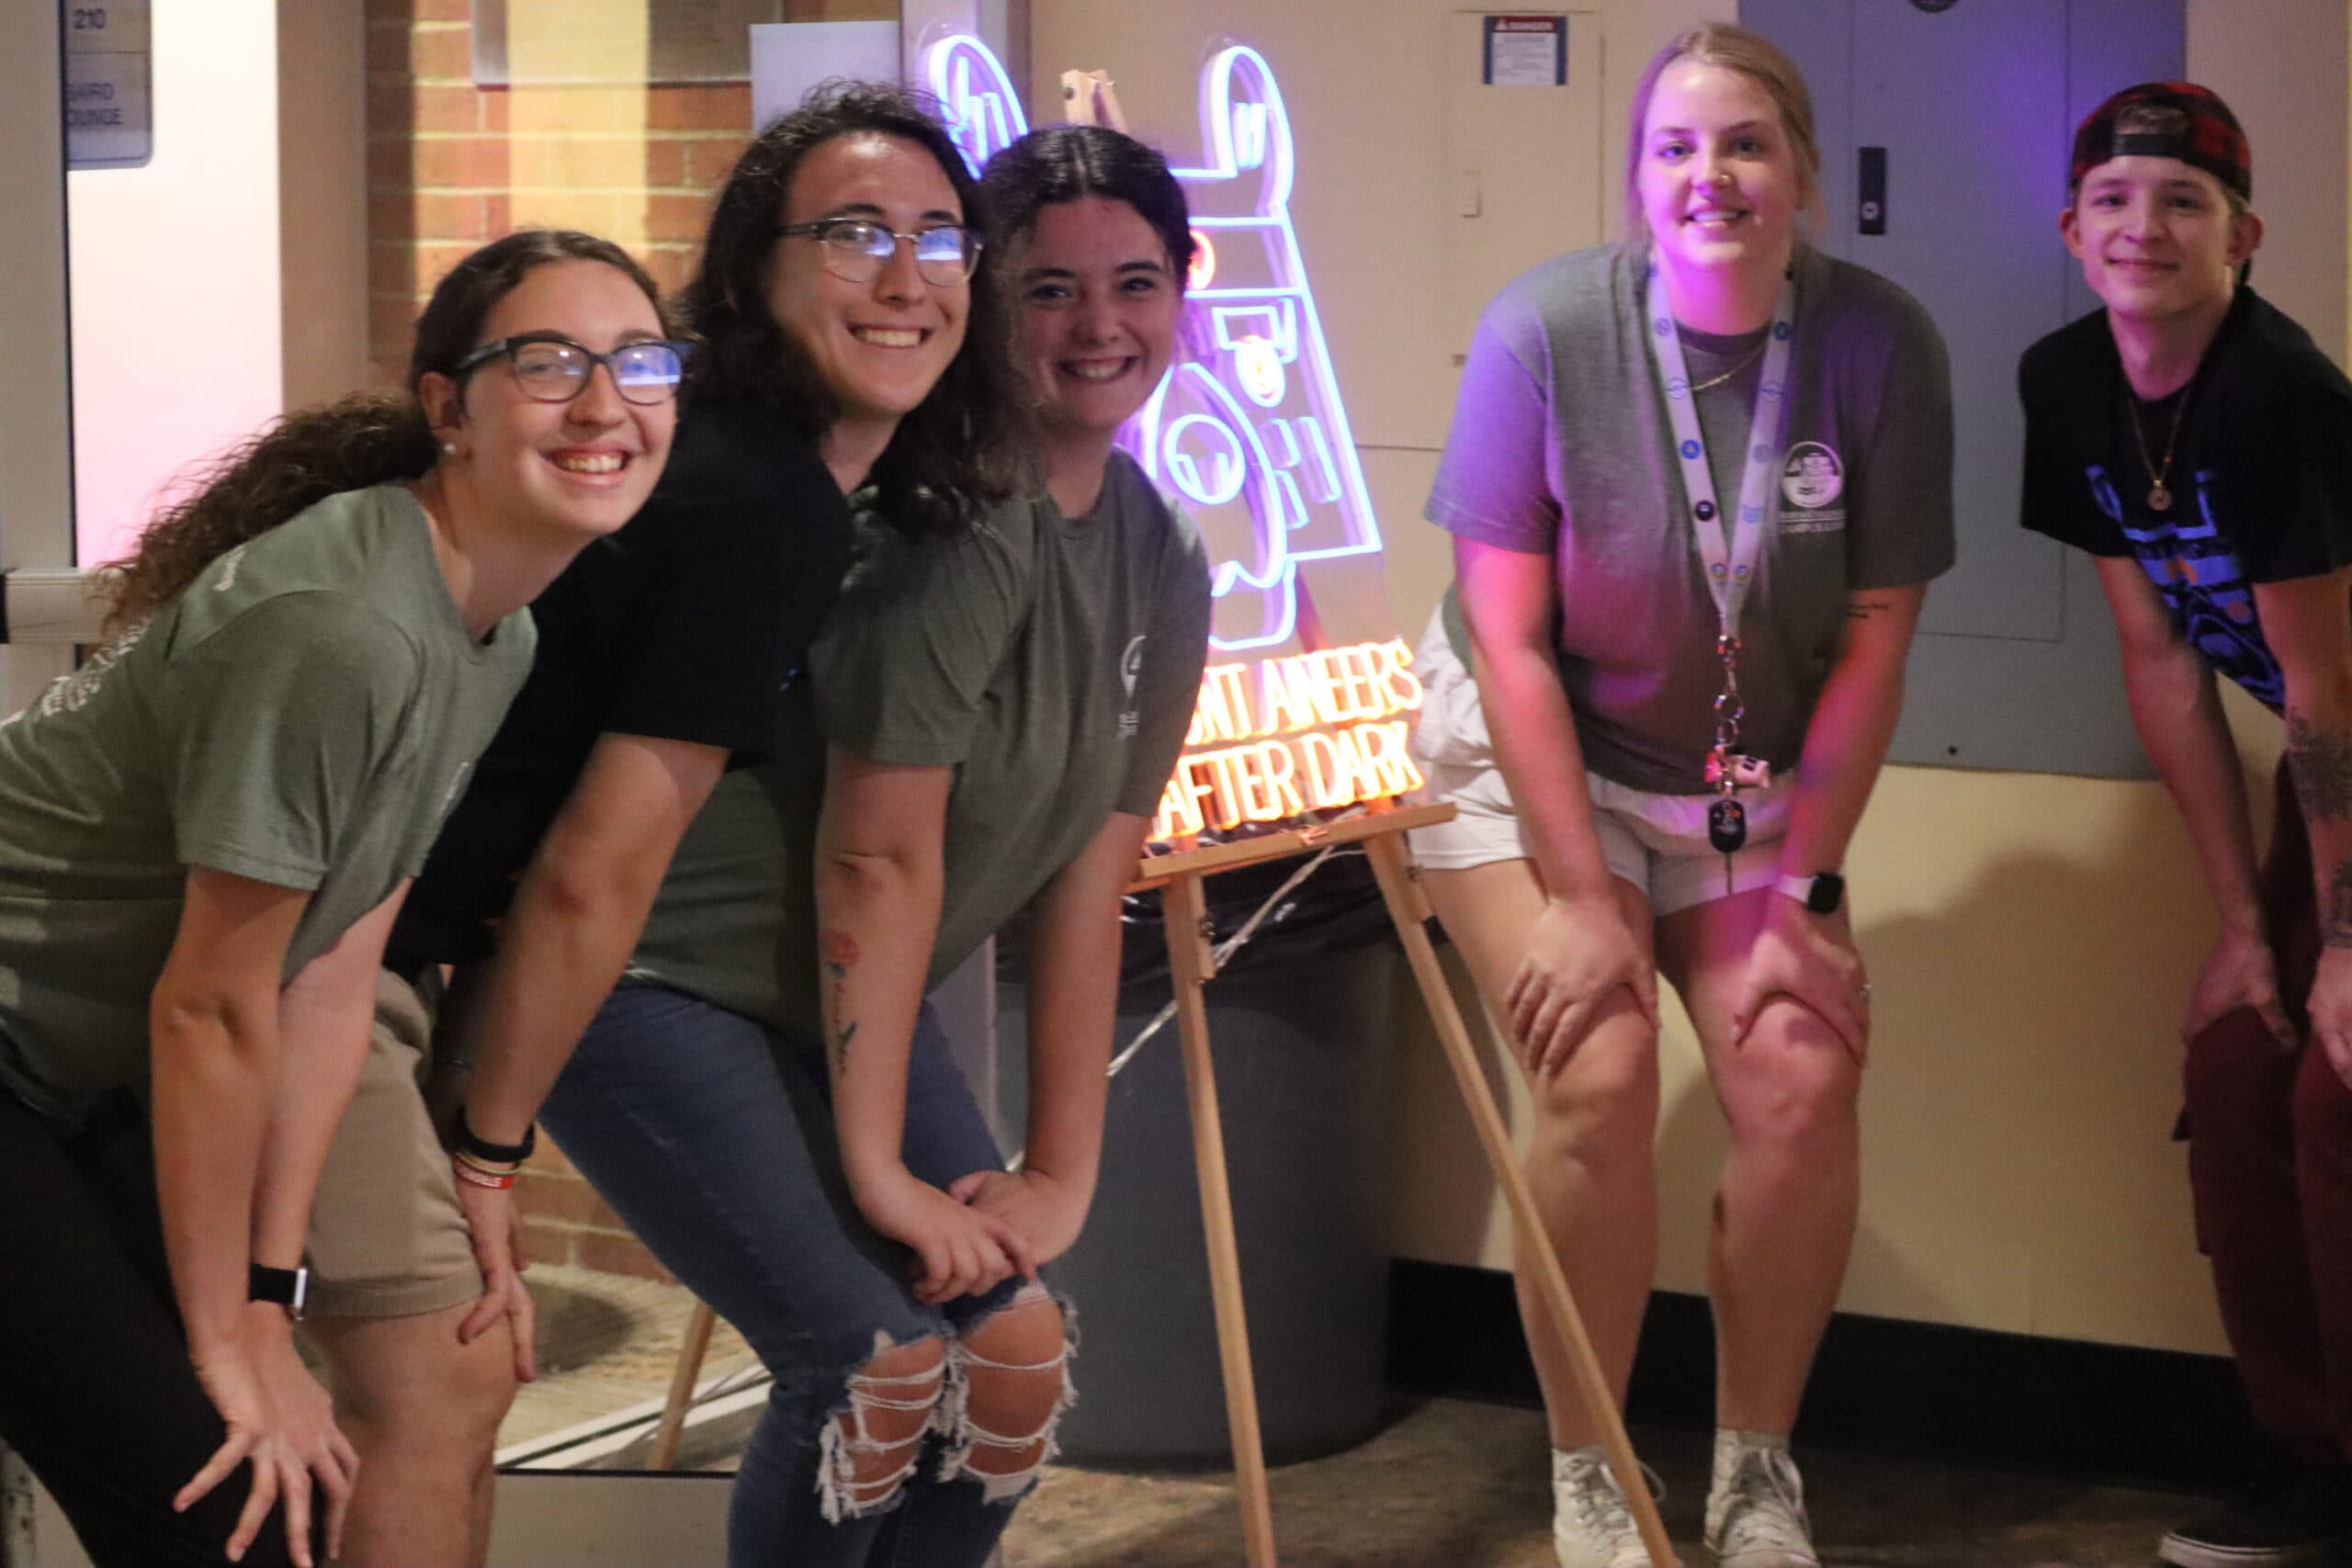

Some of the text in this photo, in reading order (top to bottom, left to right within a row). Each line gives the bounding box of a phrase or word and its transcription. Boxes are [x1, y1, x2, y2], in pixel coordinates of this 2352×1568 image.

[73, 7, 107, 29] 210
[66, 107, 124, 127] OUNGE
[1150, 720, 1424, 840] AFTER DARK
